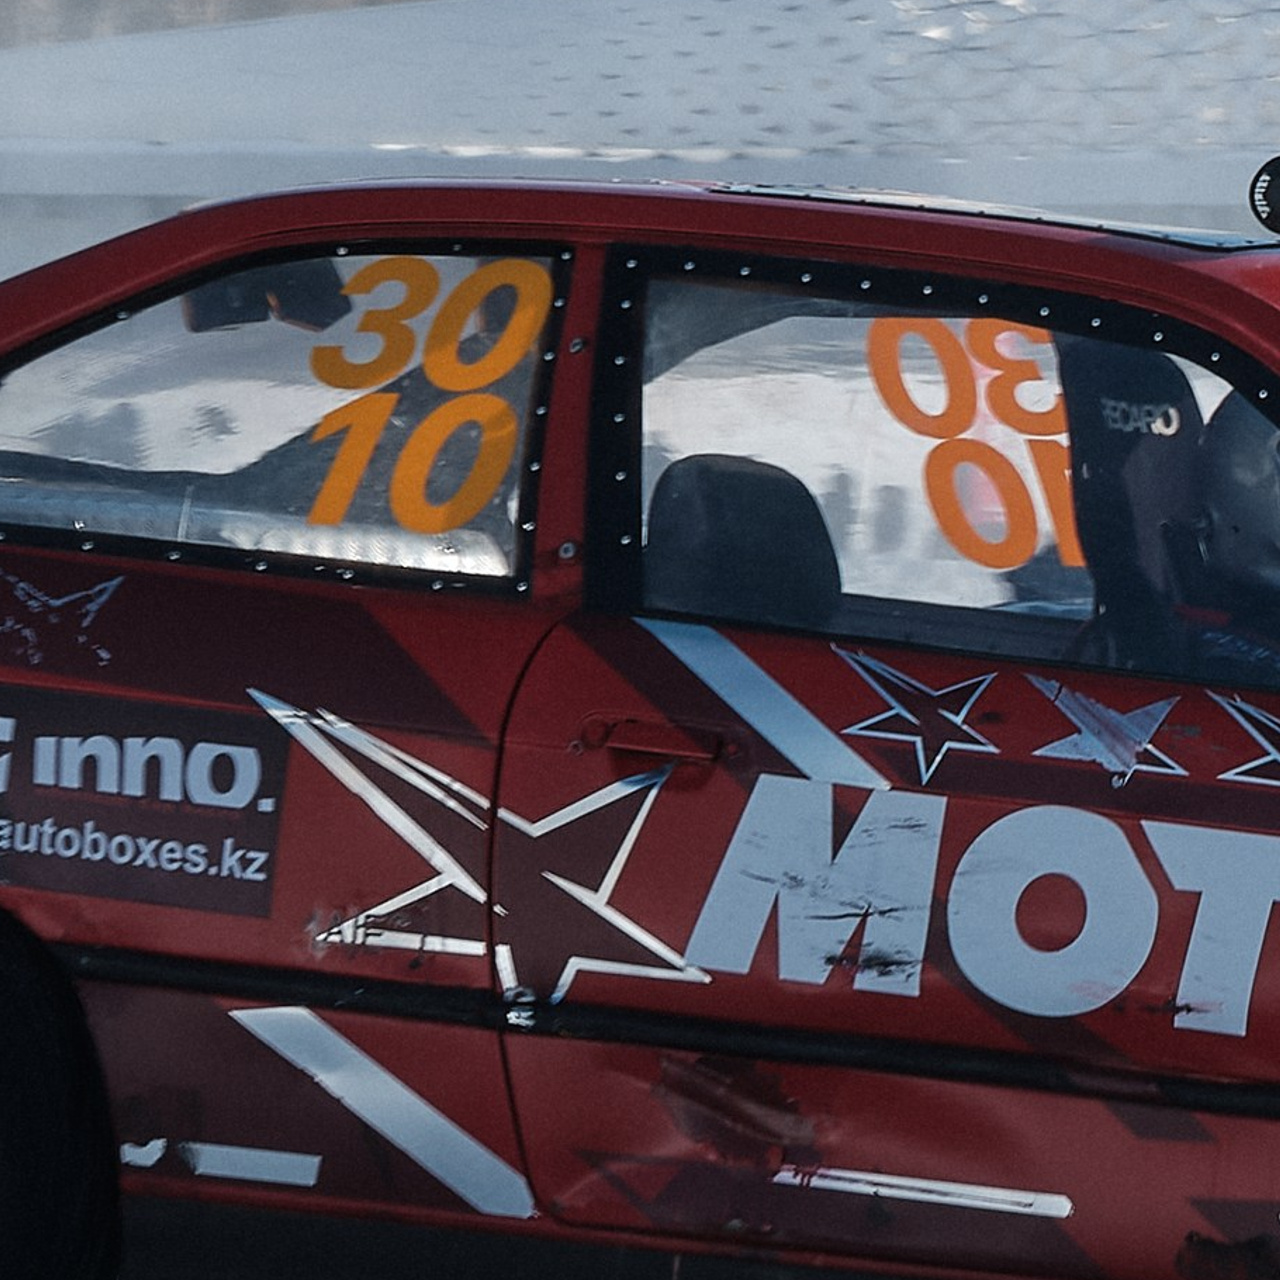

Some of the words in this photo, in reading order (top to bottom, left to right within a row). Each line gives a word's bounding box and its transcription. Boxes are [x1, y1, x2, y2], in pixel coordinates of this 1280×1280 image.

[309, 255, 554, 391] 30
[306, 392, 519, 535] 10
[1100, 397, 1181, 436] ECARO
